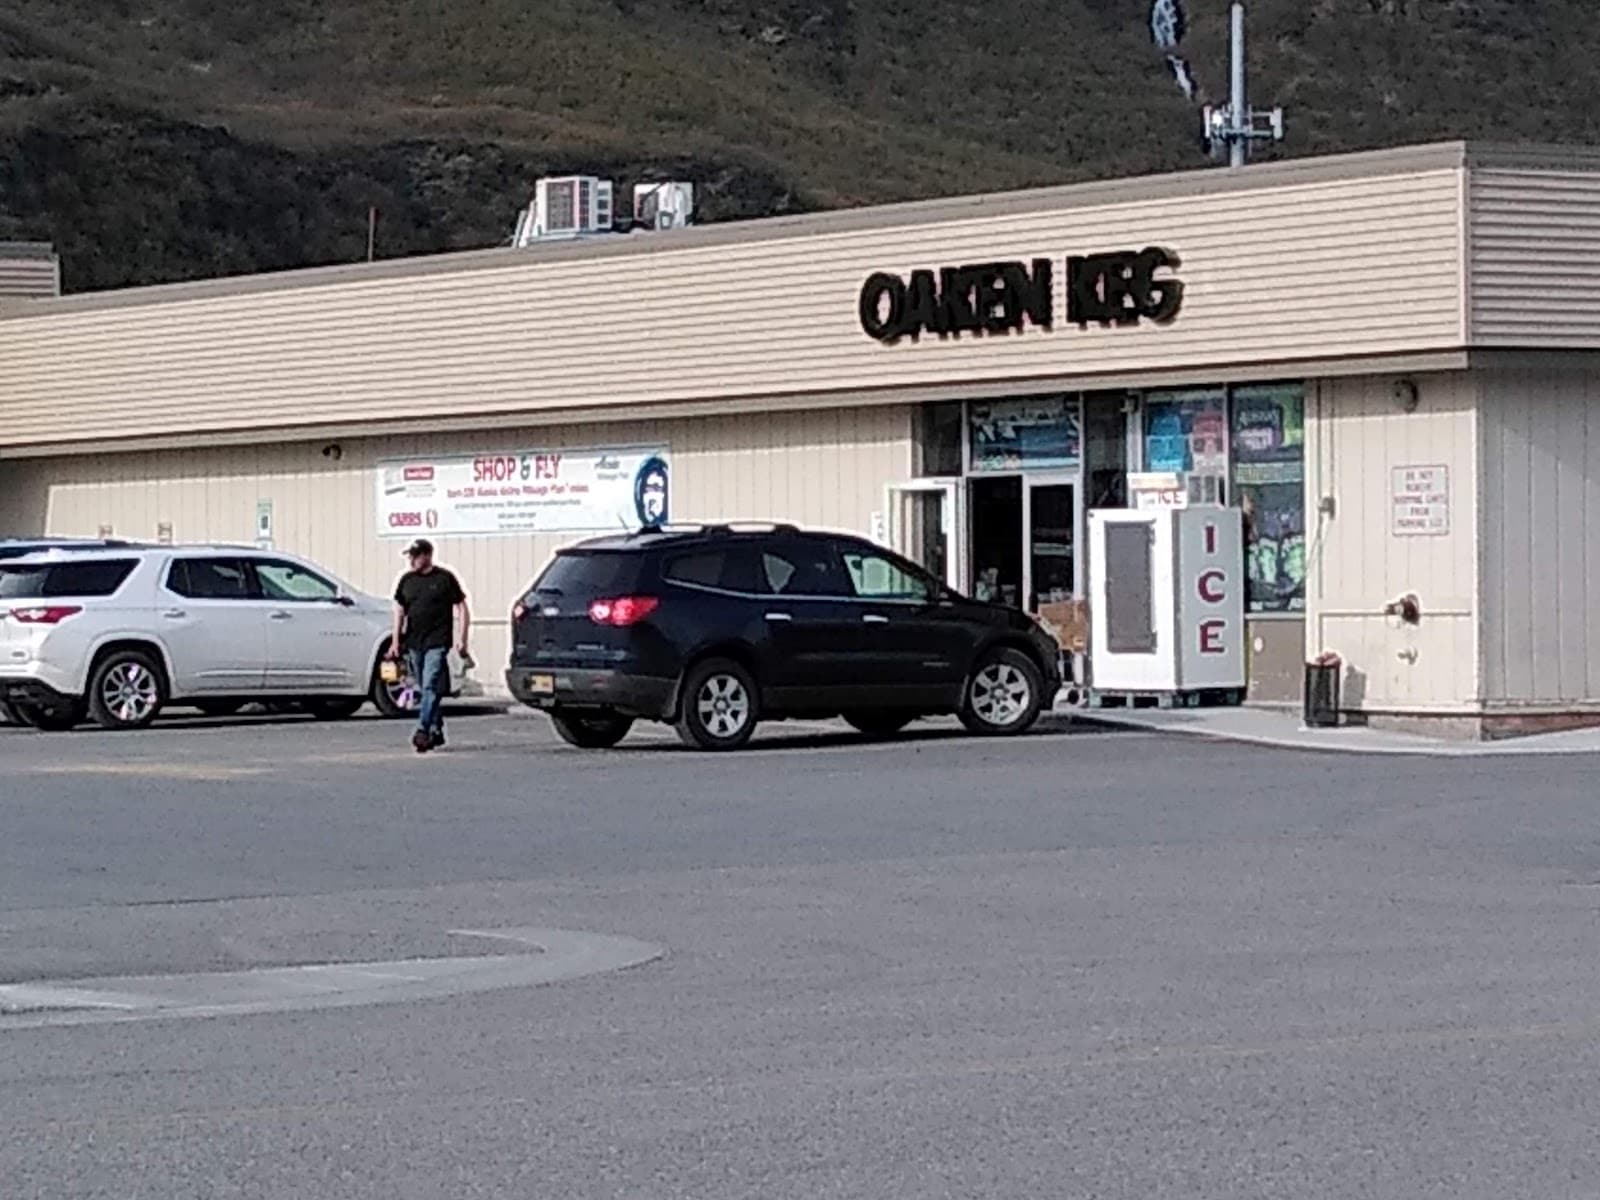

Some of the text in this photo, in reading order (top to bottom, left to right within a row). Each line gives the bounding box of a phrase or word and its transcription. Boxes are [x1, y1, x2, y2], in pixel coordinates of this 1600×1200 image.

[859, 246, 1185, 345] OAKEN KEG
[473, 453, 562, 482] SHOP & FLY
[1157, 489, 1183, 505] ICE
[1198, 525, 1226, 653] ICE
